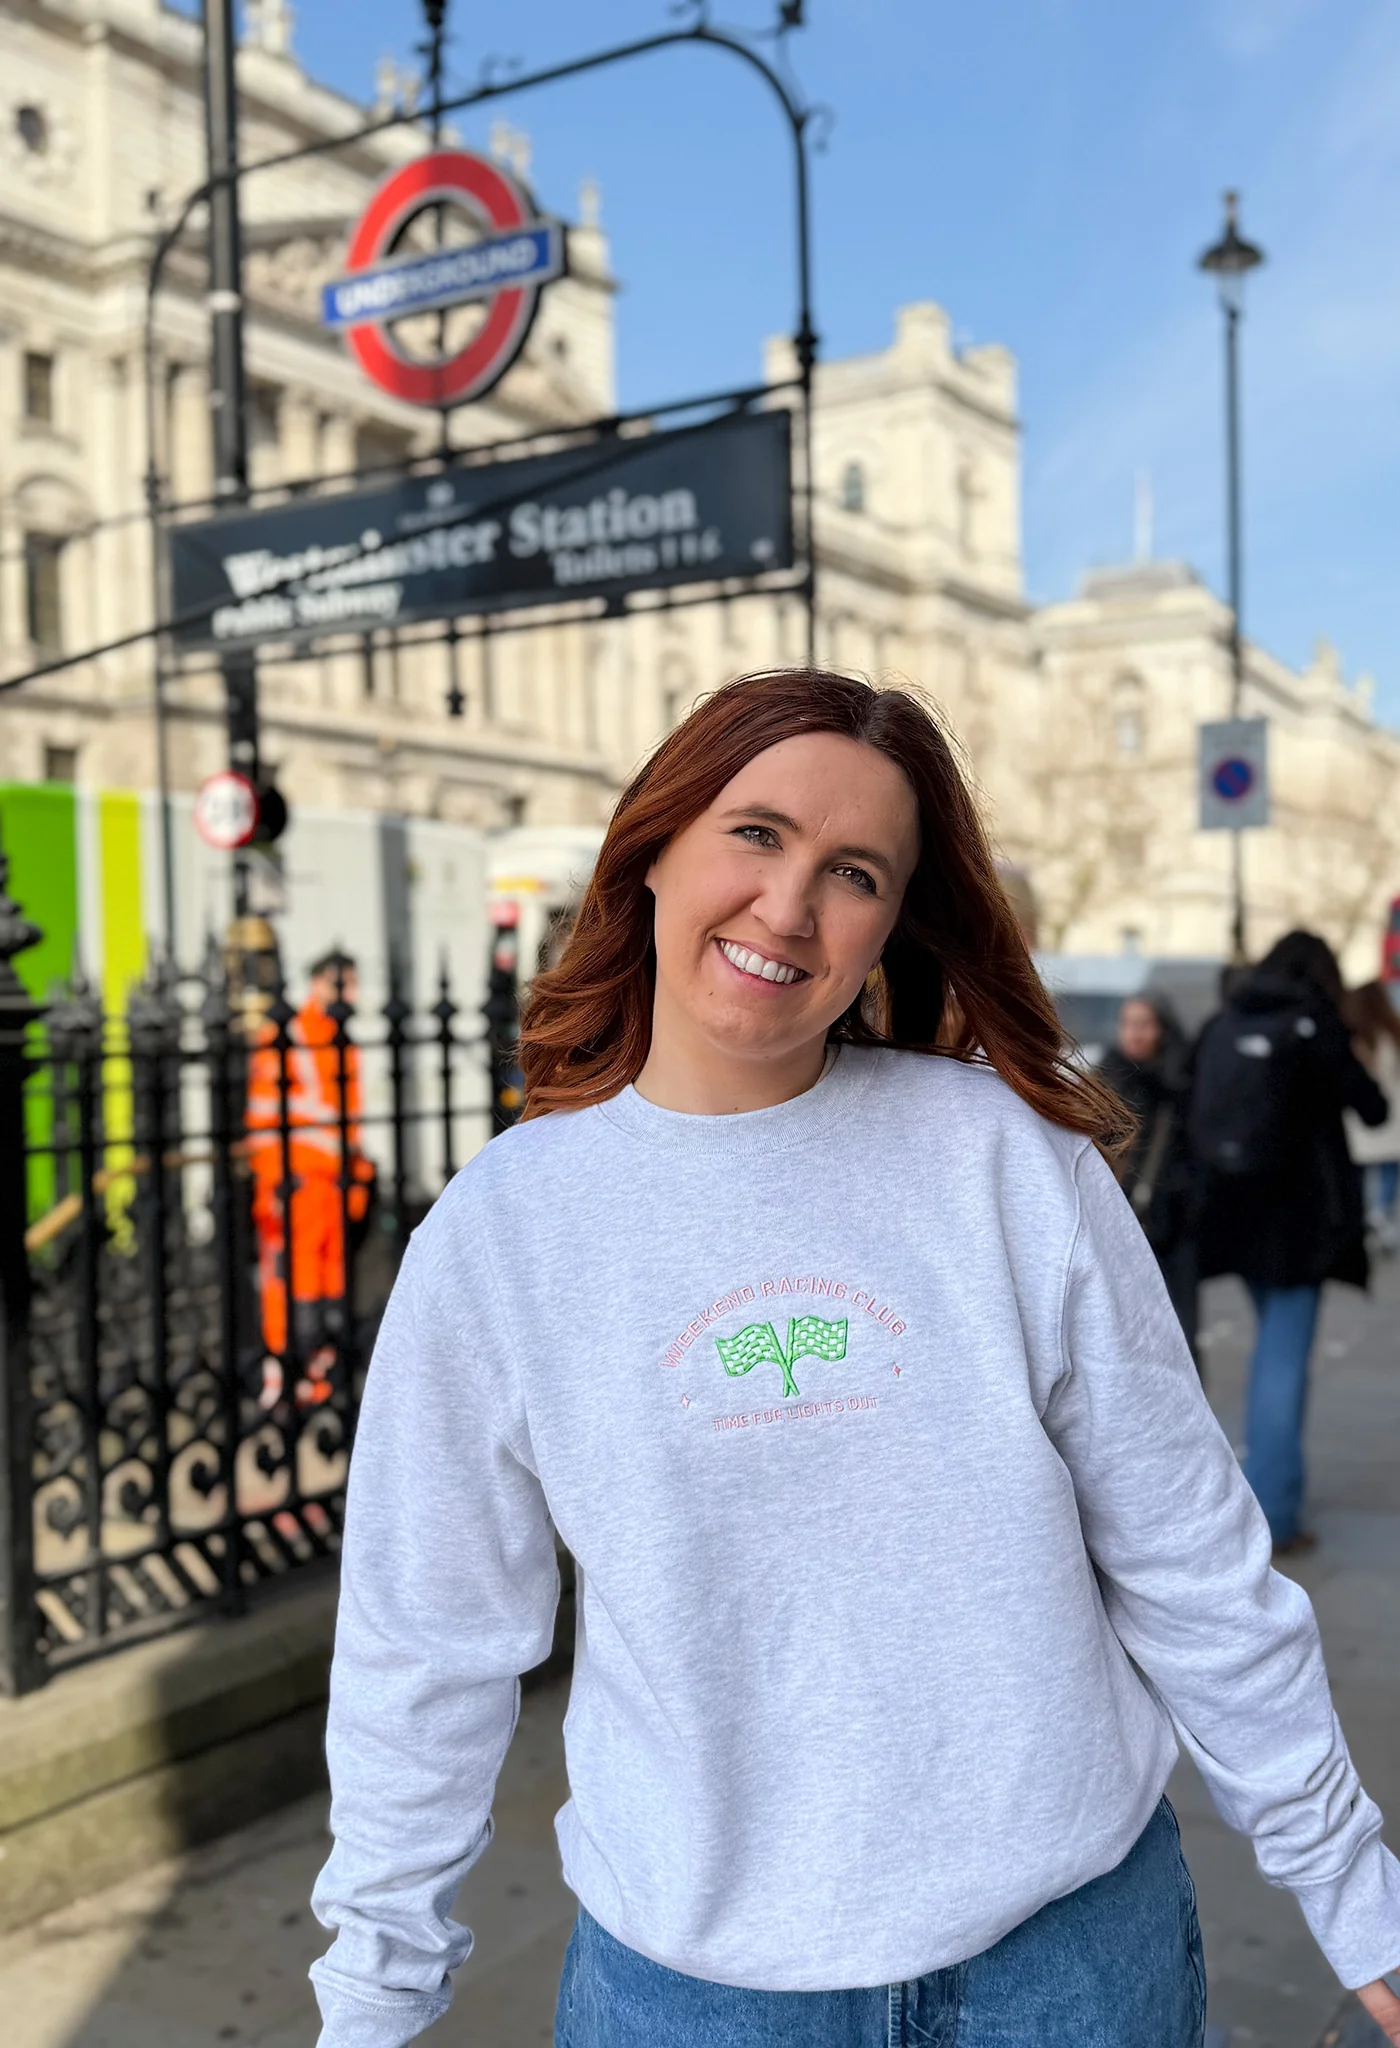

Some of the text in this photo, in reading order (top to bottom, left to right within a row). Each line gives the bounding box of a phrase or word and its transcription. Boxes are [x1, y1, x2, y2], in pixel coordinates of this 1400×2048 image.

[508, 487, 698, 558] Station
[660, 1276, 907, 1368] WEEKEND RACING CLUB
[713, 1395, 878, 1431] TIME FOR LIGHTS OUT
